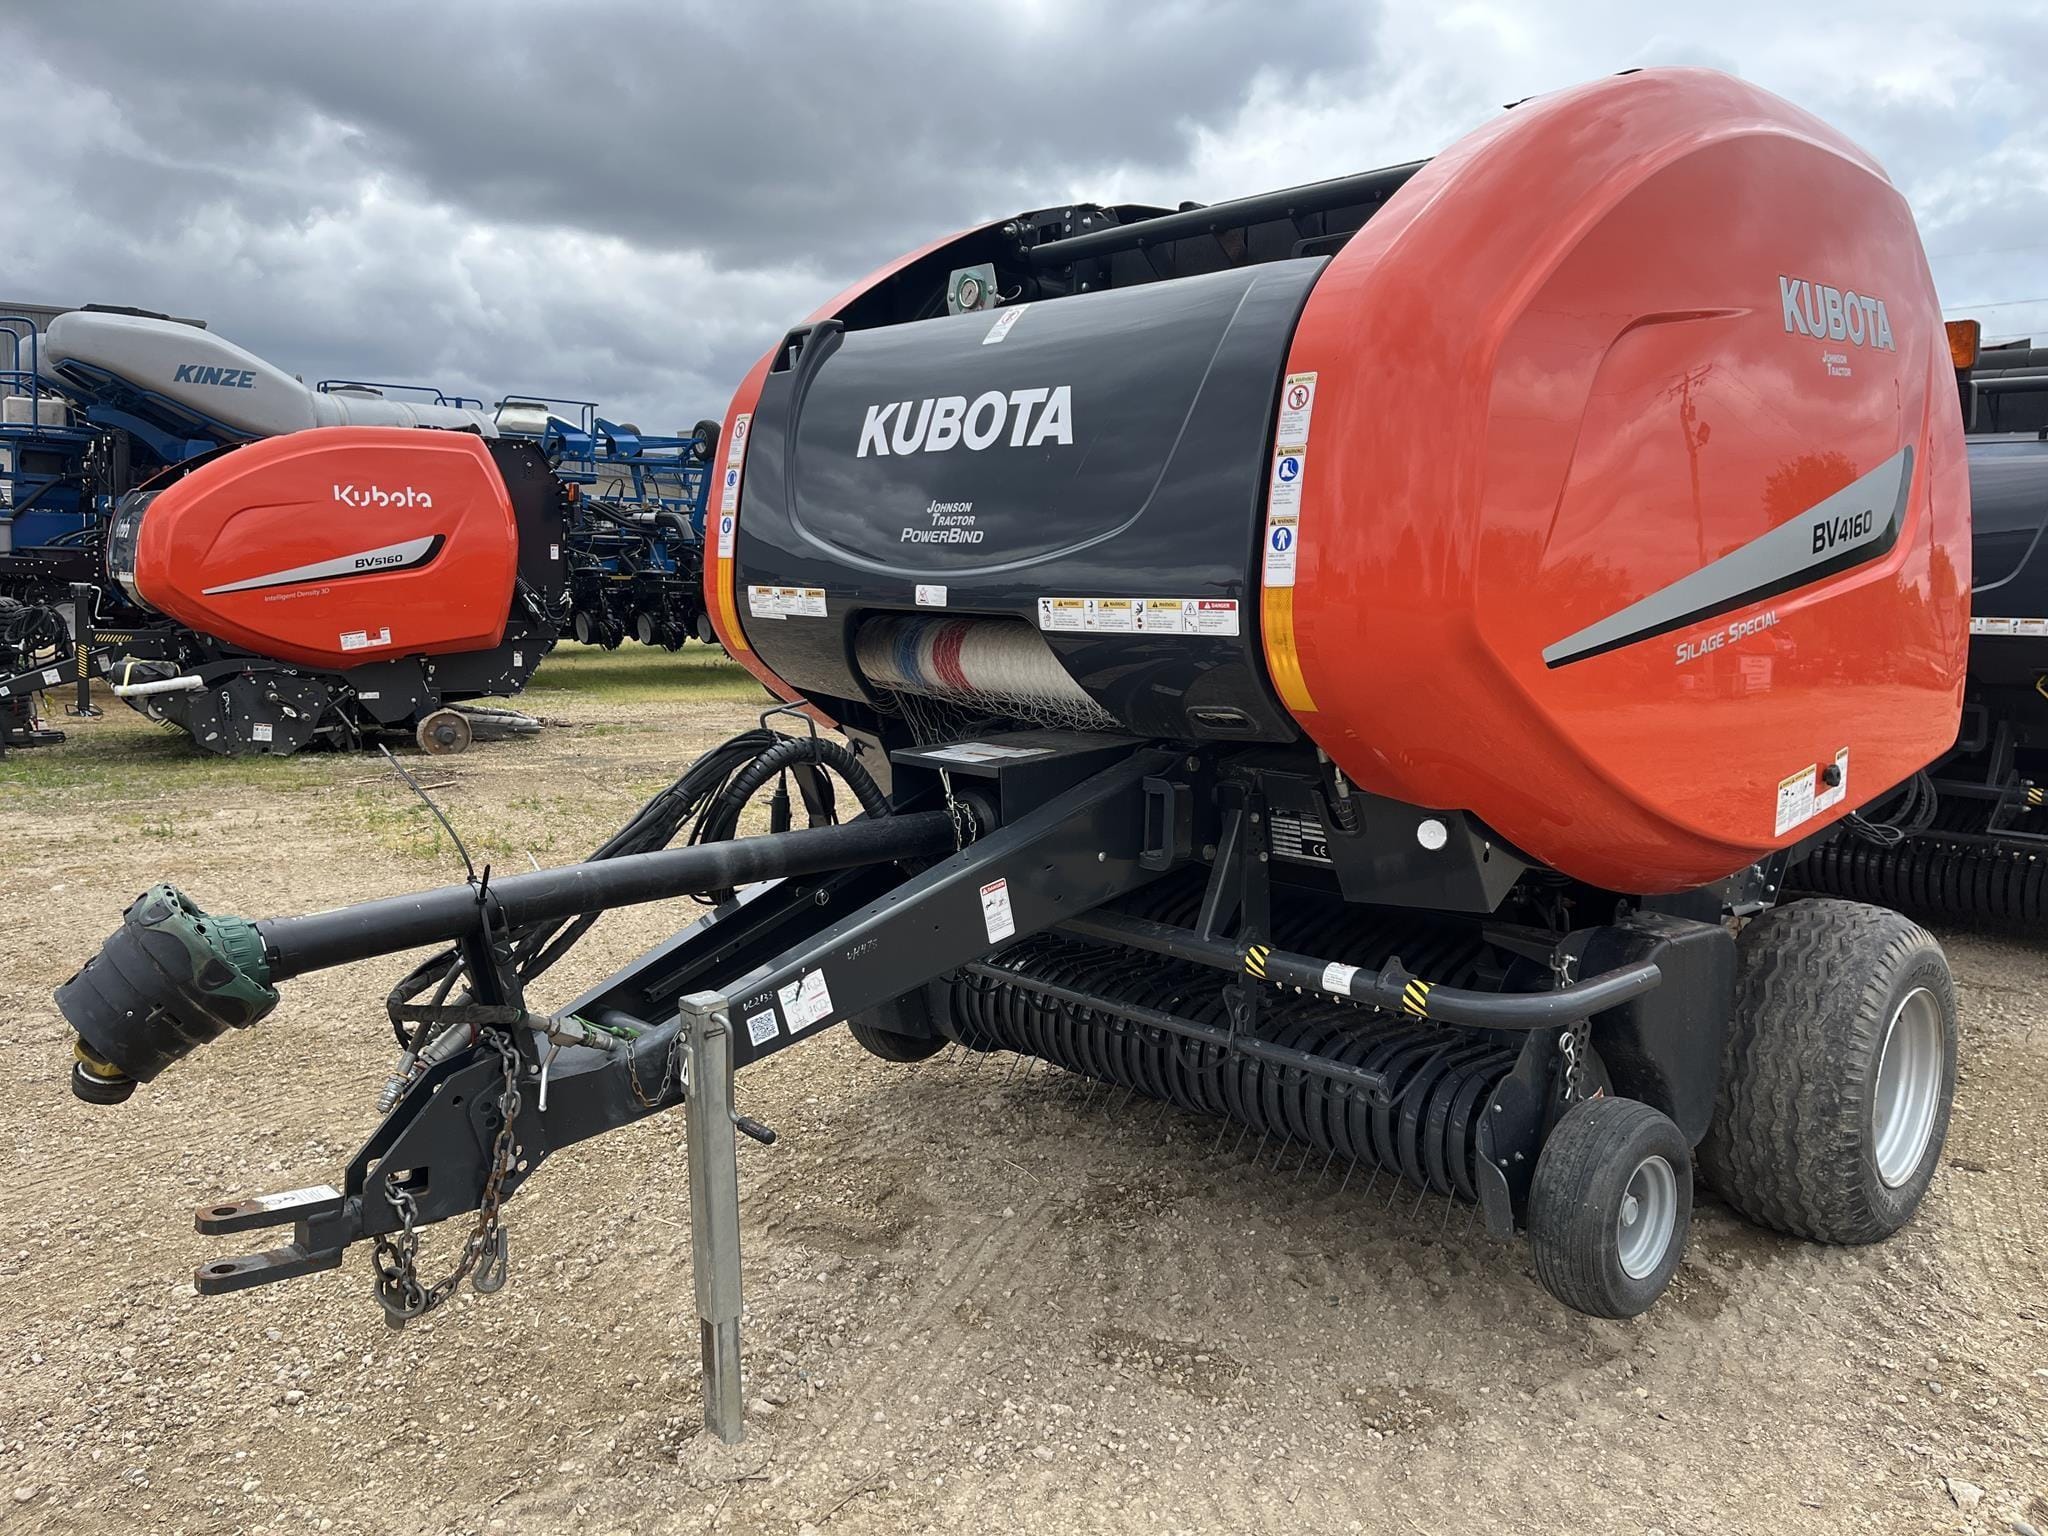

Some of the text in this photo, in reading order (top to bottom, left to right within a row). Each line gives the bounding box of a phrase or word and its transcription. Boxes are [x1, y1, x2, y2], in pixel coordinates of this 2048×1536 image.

[1779, 275, 1896, 352] KUBOTA
[173, 364, 256, 389] KINZE
[856, 385, 1074, 458] KUBOTA
[333, 485, 433, 507] Kubota
[926, 500, 973, 514] JOHNSON
[932, 513, 976, 526] TRACTOR
[900, 527, 984, 543] POWERBIND
[1812, 509, 1873, 555] BV4160
[355, 554, 403, 569] BV5160
[264, 587, 330, 602] Intelligent Density 3D
[1675, 610, 1780, 665] SILAGE SPECIAL
